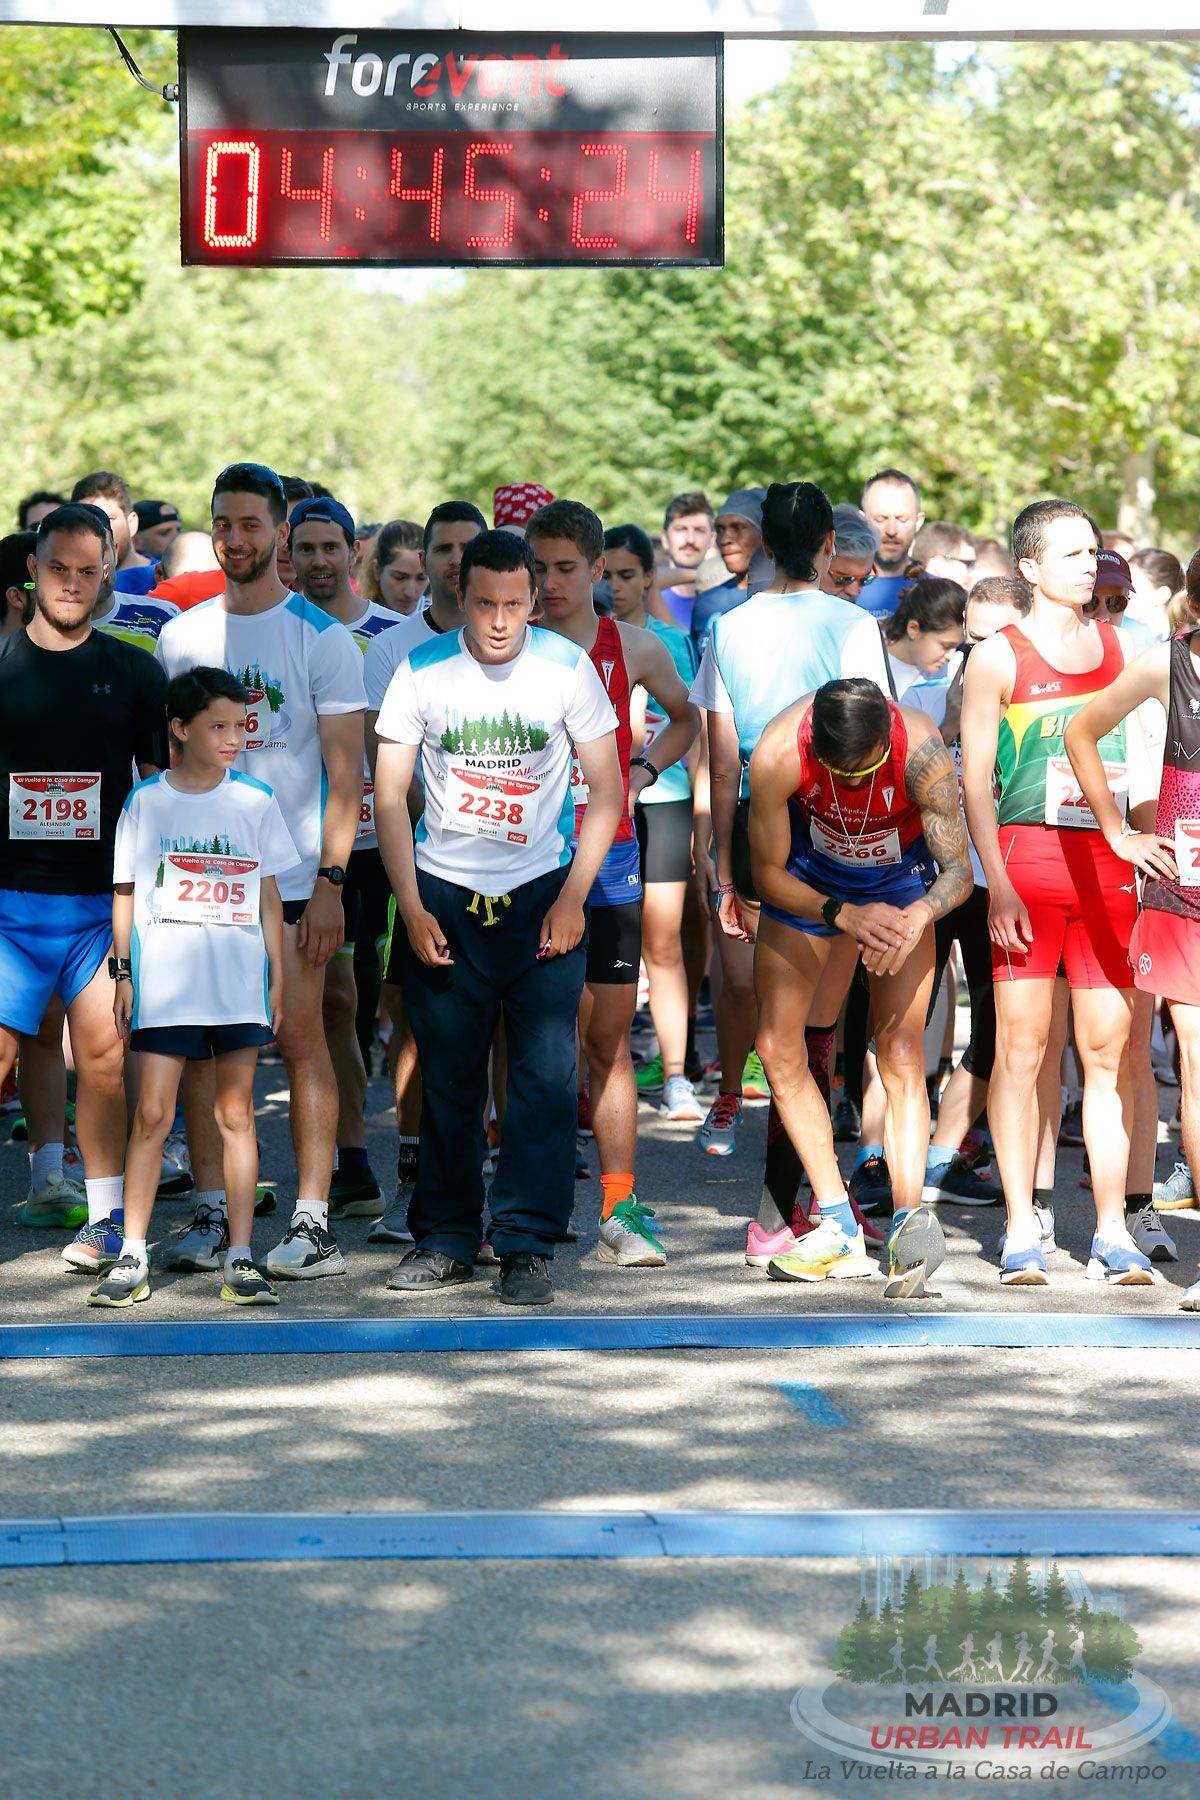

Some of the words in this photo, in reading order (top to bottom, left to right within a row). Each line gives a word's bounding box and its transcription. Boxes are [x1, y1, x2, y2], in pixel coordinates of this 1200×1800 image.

[323, 34, 569, 97] forevent
[406, 102, 447, 111] SPORTS
[454, 102, 520, 112] EXPERIENCE
[204, 141, 700, 248] 04:45:24
[465, 758, 522, 769] MADRID
[22, 798, 88, 821] 2198
[458, 792, 524, 825] 2238
[823, 839, 887, 859] 2266
[178, 879, 246, 905] 2205
